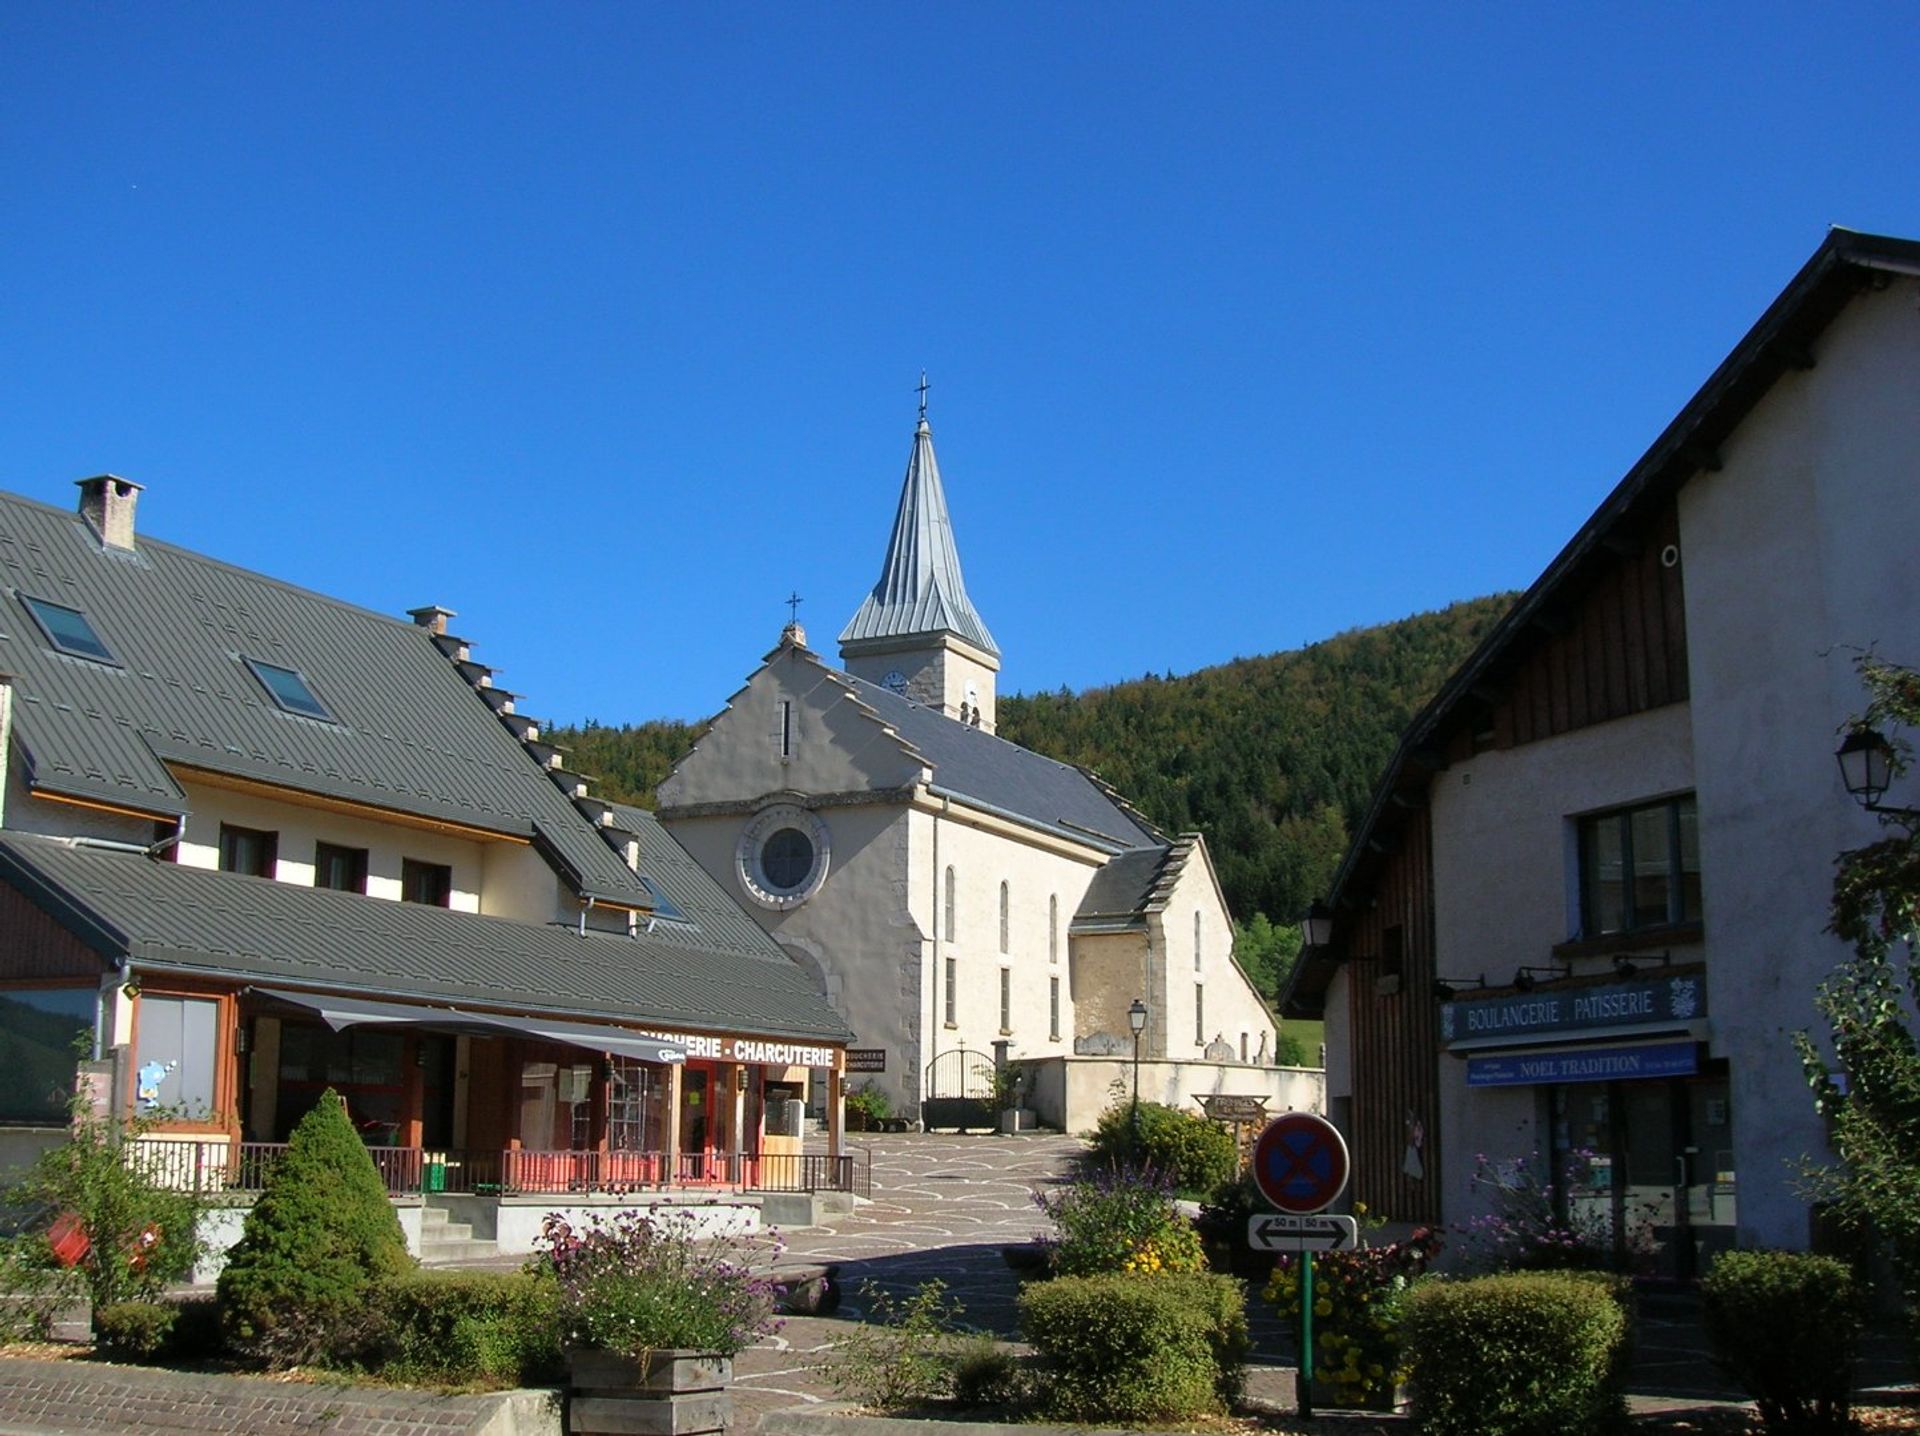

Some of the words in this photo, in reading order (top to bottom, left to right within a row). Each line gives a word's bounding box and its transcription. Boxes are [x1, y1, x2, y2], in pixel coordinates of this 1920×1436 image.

[1468, 1000, 1559, 1031] BOULANGERIE
[1574, 990, 1654, 1021] PATISSERIE
[734, 1040, 834, 1067] CHARCUTERIE
[1520, 1061, 1557, 1078] NOEL
[1560, 1055, 1641, 1076] TRADITION
[1274, 1218, 1286, 1227] 50
[1305, 1218, 1317, 1227] 50
